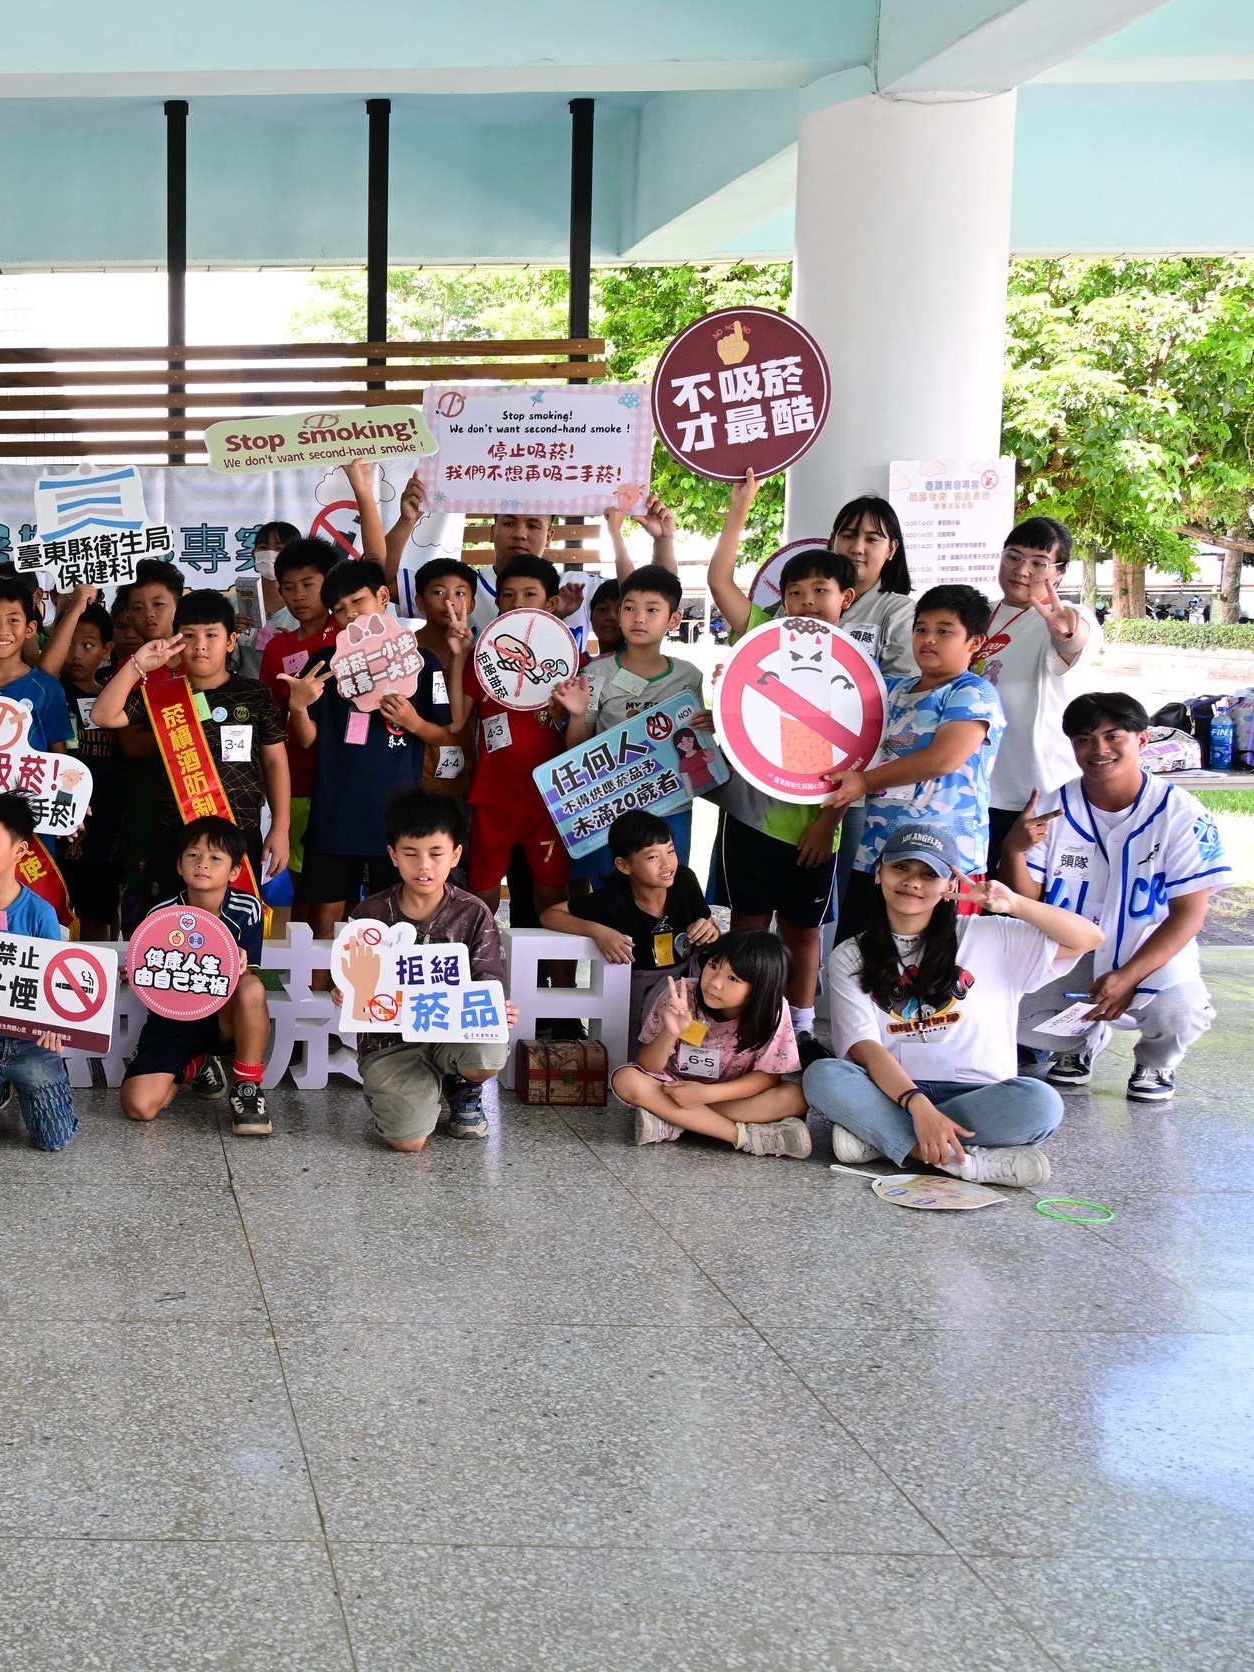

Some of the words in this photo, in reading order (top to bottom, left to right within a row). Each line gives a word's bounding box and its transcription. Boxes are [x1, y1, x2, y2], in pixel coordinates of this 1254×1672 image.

[712, 329, 723, 340] NO
[671, 355, 803, 413] 不吸菸
[449, 424, 465, 434] We
[467, 423, 493, 434] don't
[496, 425, 520, 434] want
[524, 424, 586, 434] second-hand
[590, 424, 622, 434] smoke
[502, 411, 525, 422] Stop
[529, 410, 573, 423] smoking!
[677, 394, 815, 453] 才最酷
[225, 433, 285, 452] Stop
[297, 418, 418, 445] smoking!
[224, 458, 241, 468] We
[245, 454, 273, 466] don't
[277, 452, 305, 463] want
[309, 446, 376, 460] second-hand
[381, 442, 416, 454] smoke
[487, 441, 575, 462] 停止吸菸!
[445, 464, 622, 484] 我們不想再吸二手菸!
[16, 525, 171, 572] 臺東縣衛生局
[58, 556, 135, 589] 保健科
[476, 651, 509, 700] 拒絕抽菸
[678, 708, 693, 721] NO!
[224, 739, 245, 751] 3-4
[487, 725, 504, 739] 4-3
[441, 758, 460, 768] 4-4
[551, 730, 649, 797] 任何人
[562, 758, 656, 815] 不得供應菸品予
[573, 769, 679, 838] 未滿20歲者
[540, 840, 555, 863] 7
[1060, 854, 1089, 869] 領隊
[145, 946, 220, 976] 健康人生
[396, 954, 461, 986] 拒絕
[134, 966, 230, 997] 由自己掌握
[409, 989, 500, 1033] 菸品
[689, 1054, 716, 1069] 6-5
